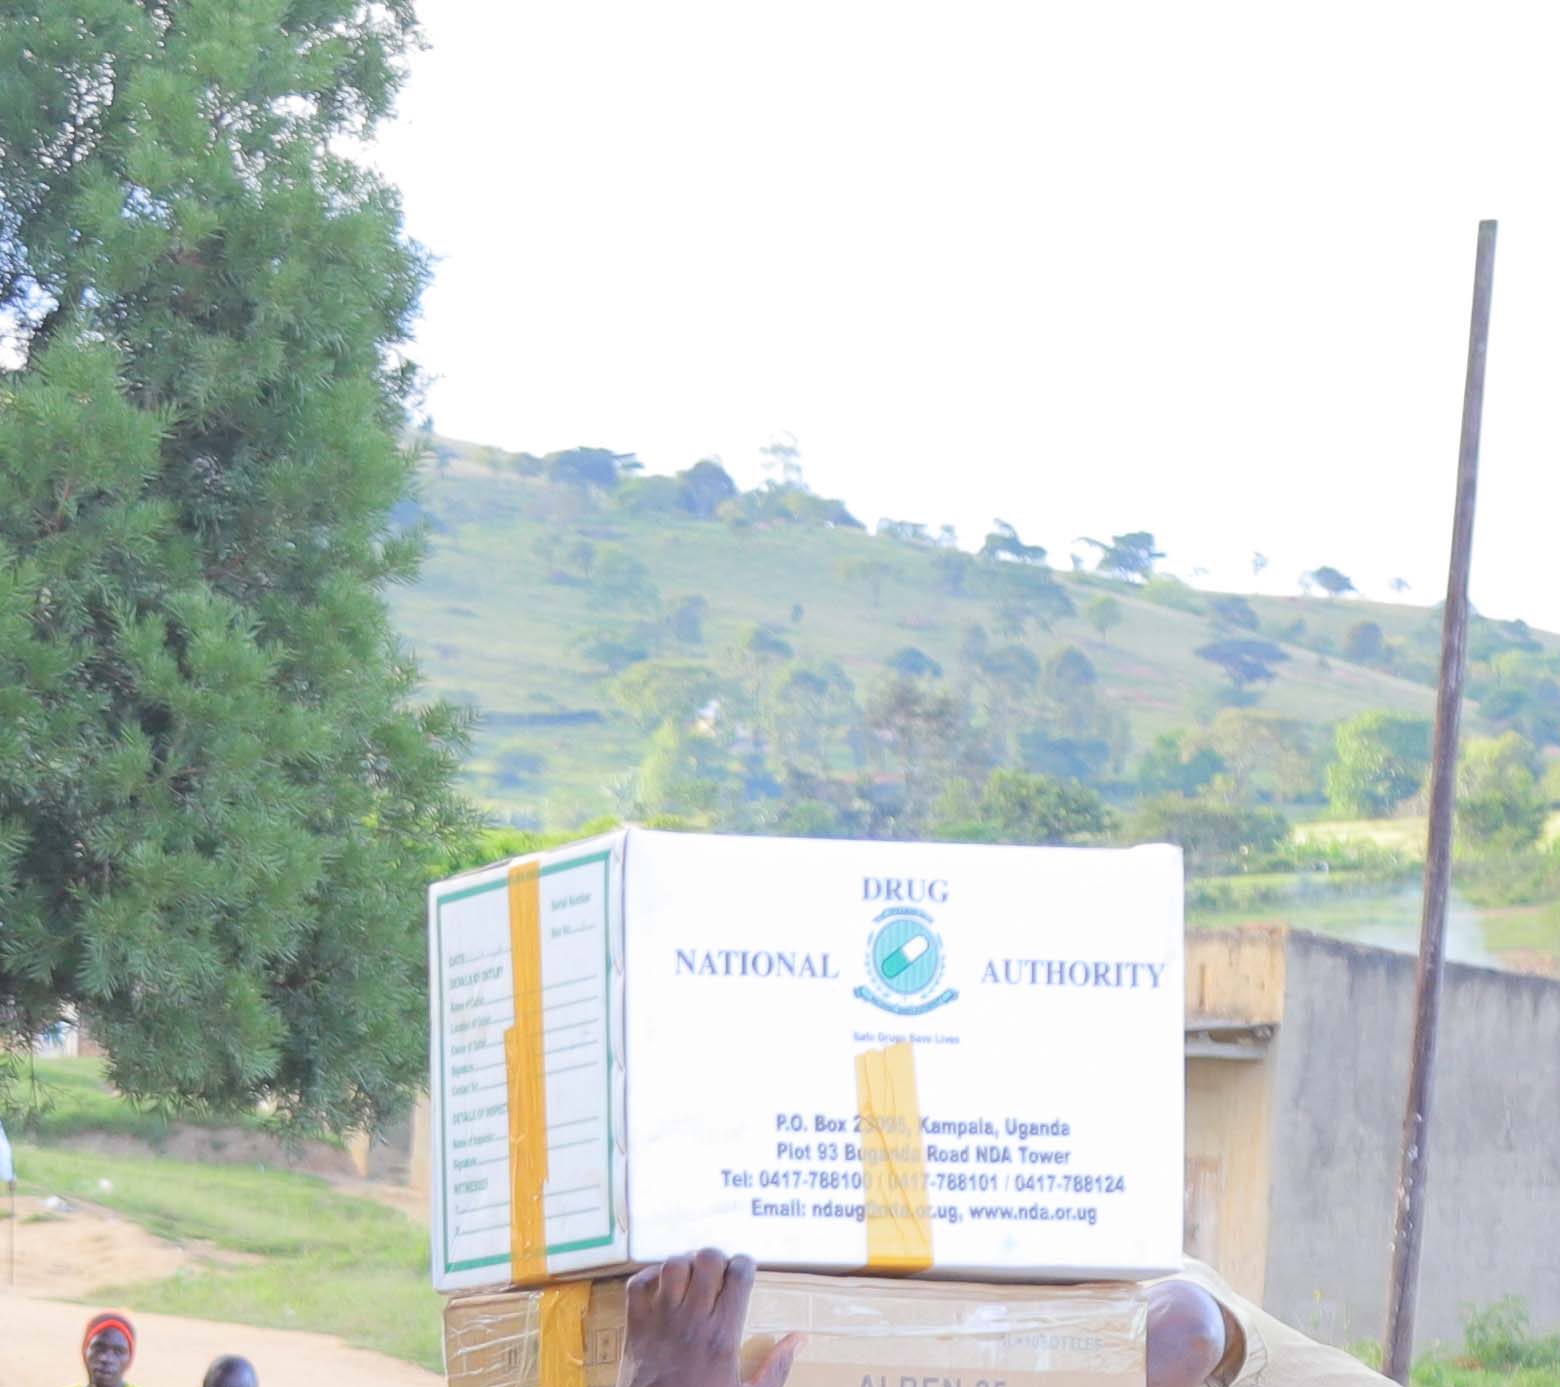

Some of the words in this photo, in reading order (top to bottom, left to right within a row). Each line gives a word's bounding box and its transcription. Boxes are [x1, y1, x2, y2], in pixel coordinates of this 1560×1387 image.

[862, 877, 949, 903] DRUG
[675, 950, 839, 980] NATIONAL
[980, 960, 1165, 988] AUTHORITY
[777, 1115, 807, 1132] P.O.
[815, 1116, 846, 1133] Box
[921, 1118, 998, 1137] Kampala,
[1005, 1119, 1070, 1138] Uganda
[778, 1144, 811, 1160] Plot
[818, 1144, 838, 1161] 93
[927, 1146, 969, 1163] Road
[977, 1147, 1011, 1163] NDA
[1018, 1147, 1070, 1164] Tower
[722, 1170, 753, 1188] Tel:
[760, 1172, 872, 1189] 0417-788100
[1015, 1175, 1126, 1193] 0417-788124
[752, 1200, 805, 1217] Email:
[970, 1205, 1097, 1224] www.nda.or.ug
